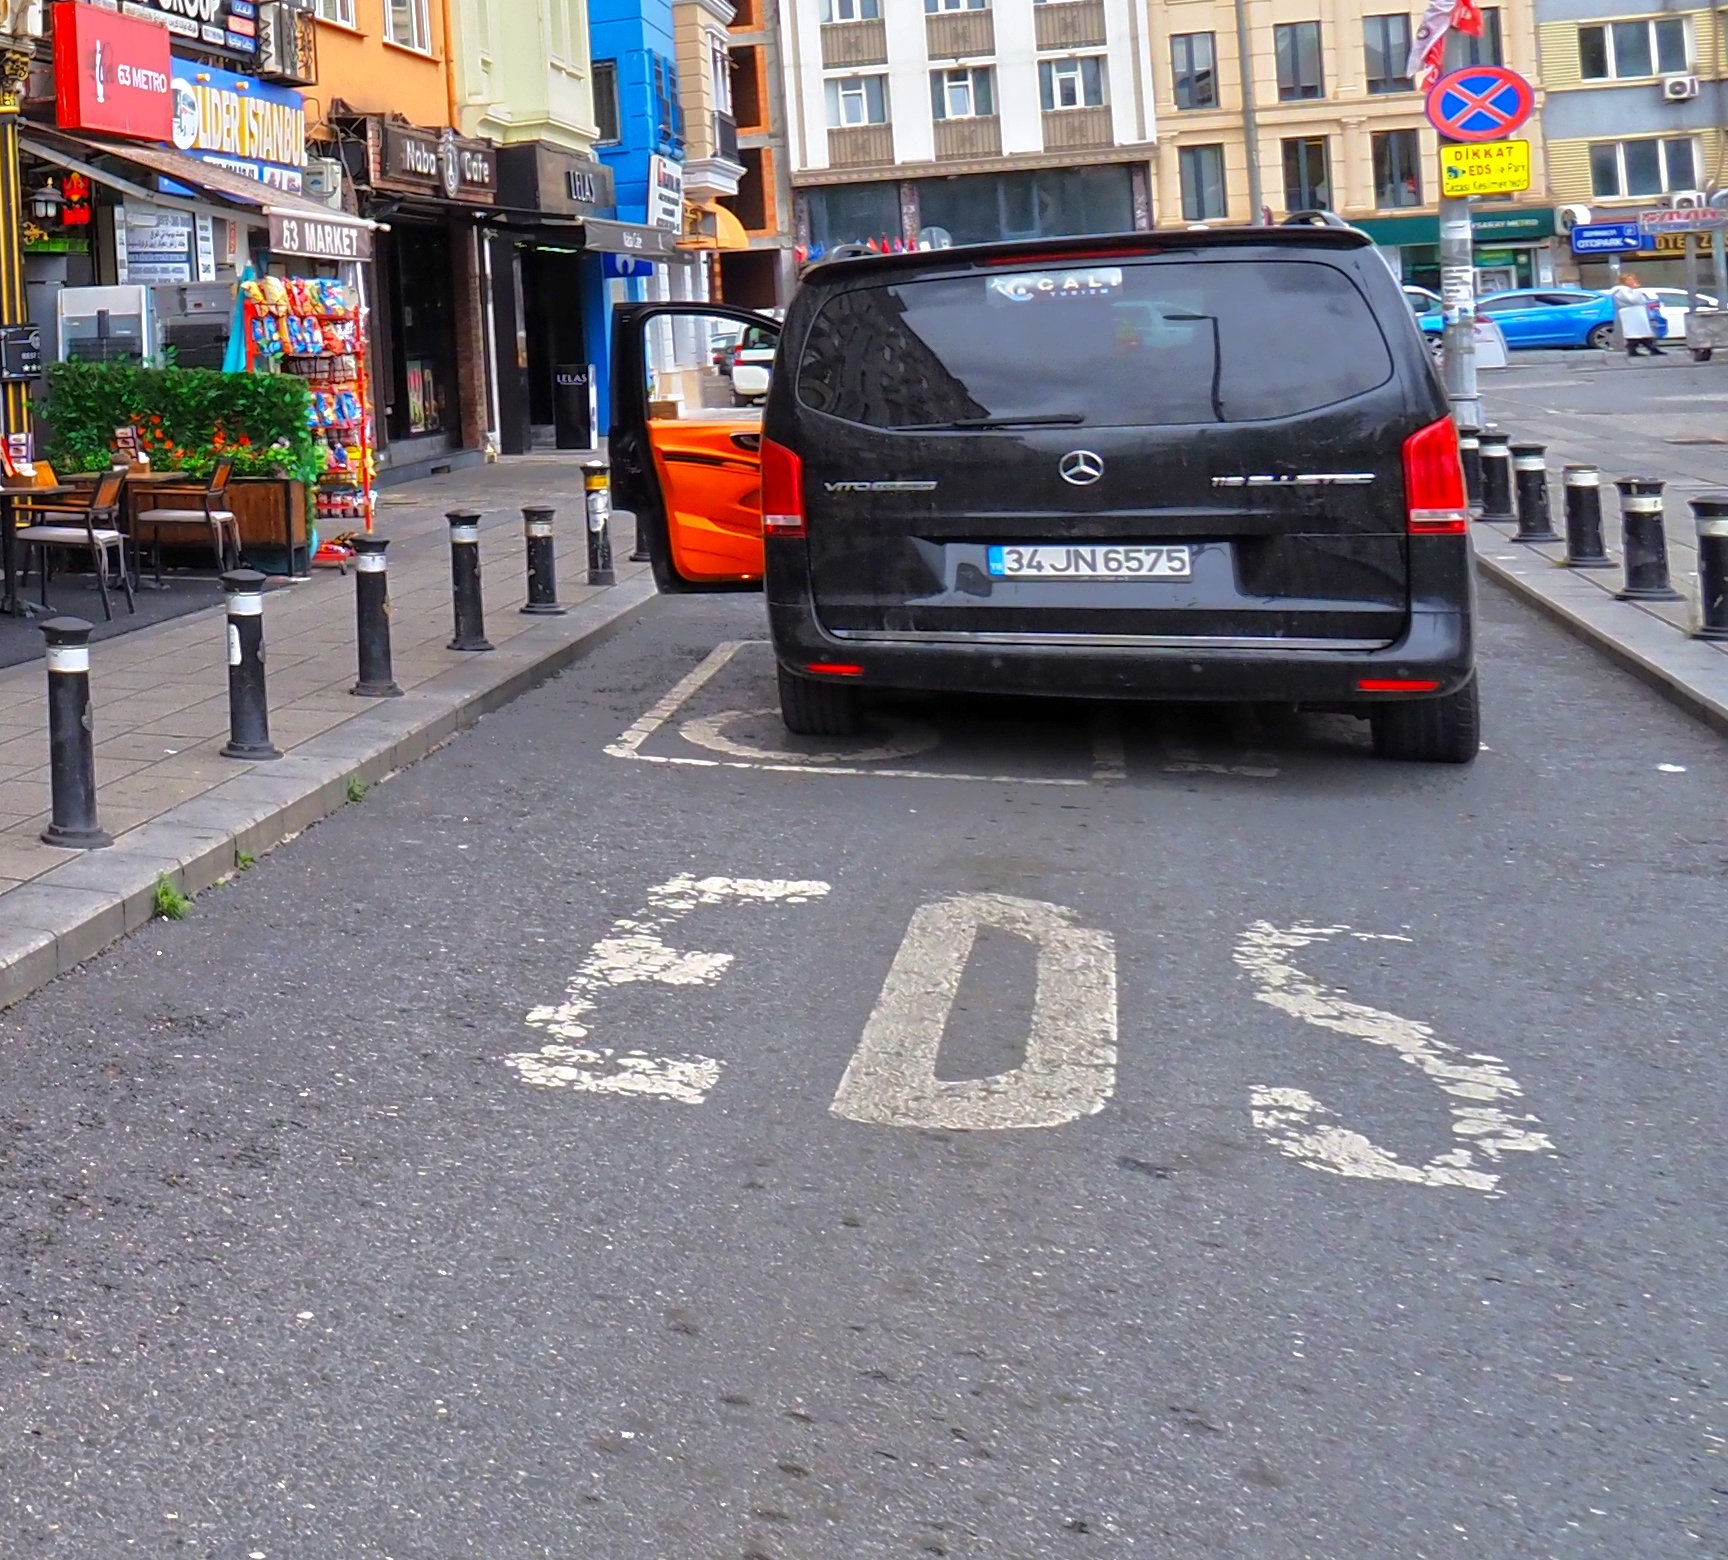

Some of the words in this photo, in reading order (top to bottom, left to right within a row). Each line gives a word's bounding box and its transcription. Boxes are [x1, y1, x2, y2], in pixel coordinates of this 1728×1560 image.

[117, 63, 131, 86] 63
[132, 66, 167, 93] METRO
[1469, 164, 1492, 176] EDS
[282, 219, 298, 251] 63
[304, 222, 358, 256] MARKET
[824, 481, 871, 492] VITO
[1005, 548, 1045, 573] 34
[1049, 548, 1098, 573] JN
[1102, 548, 1187, 573] 6575
